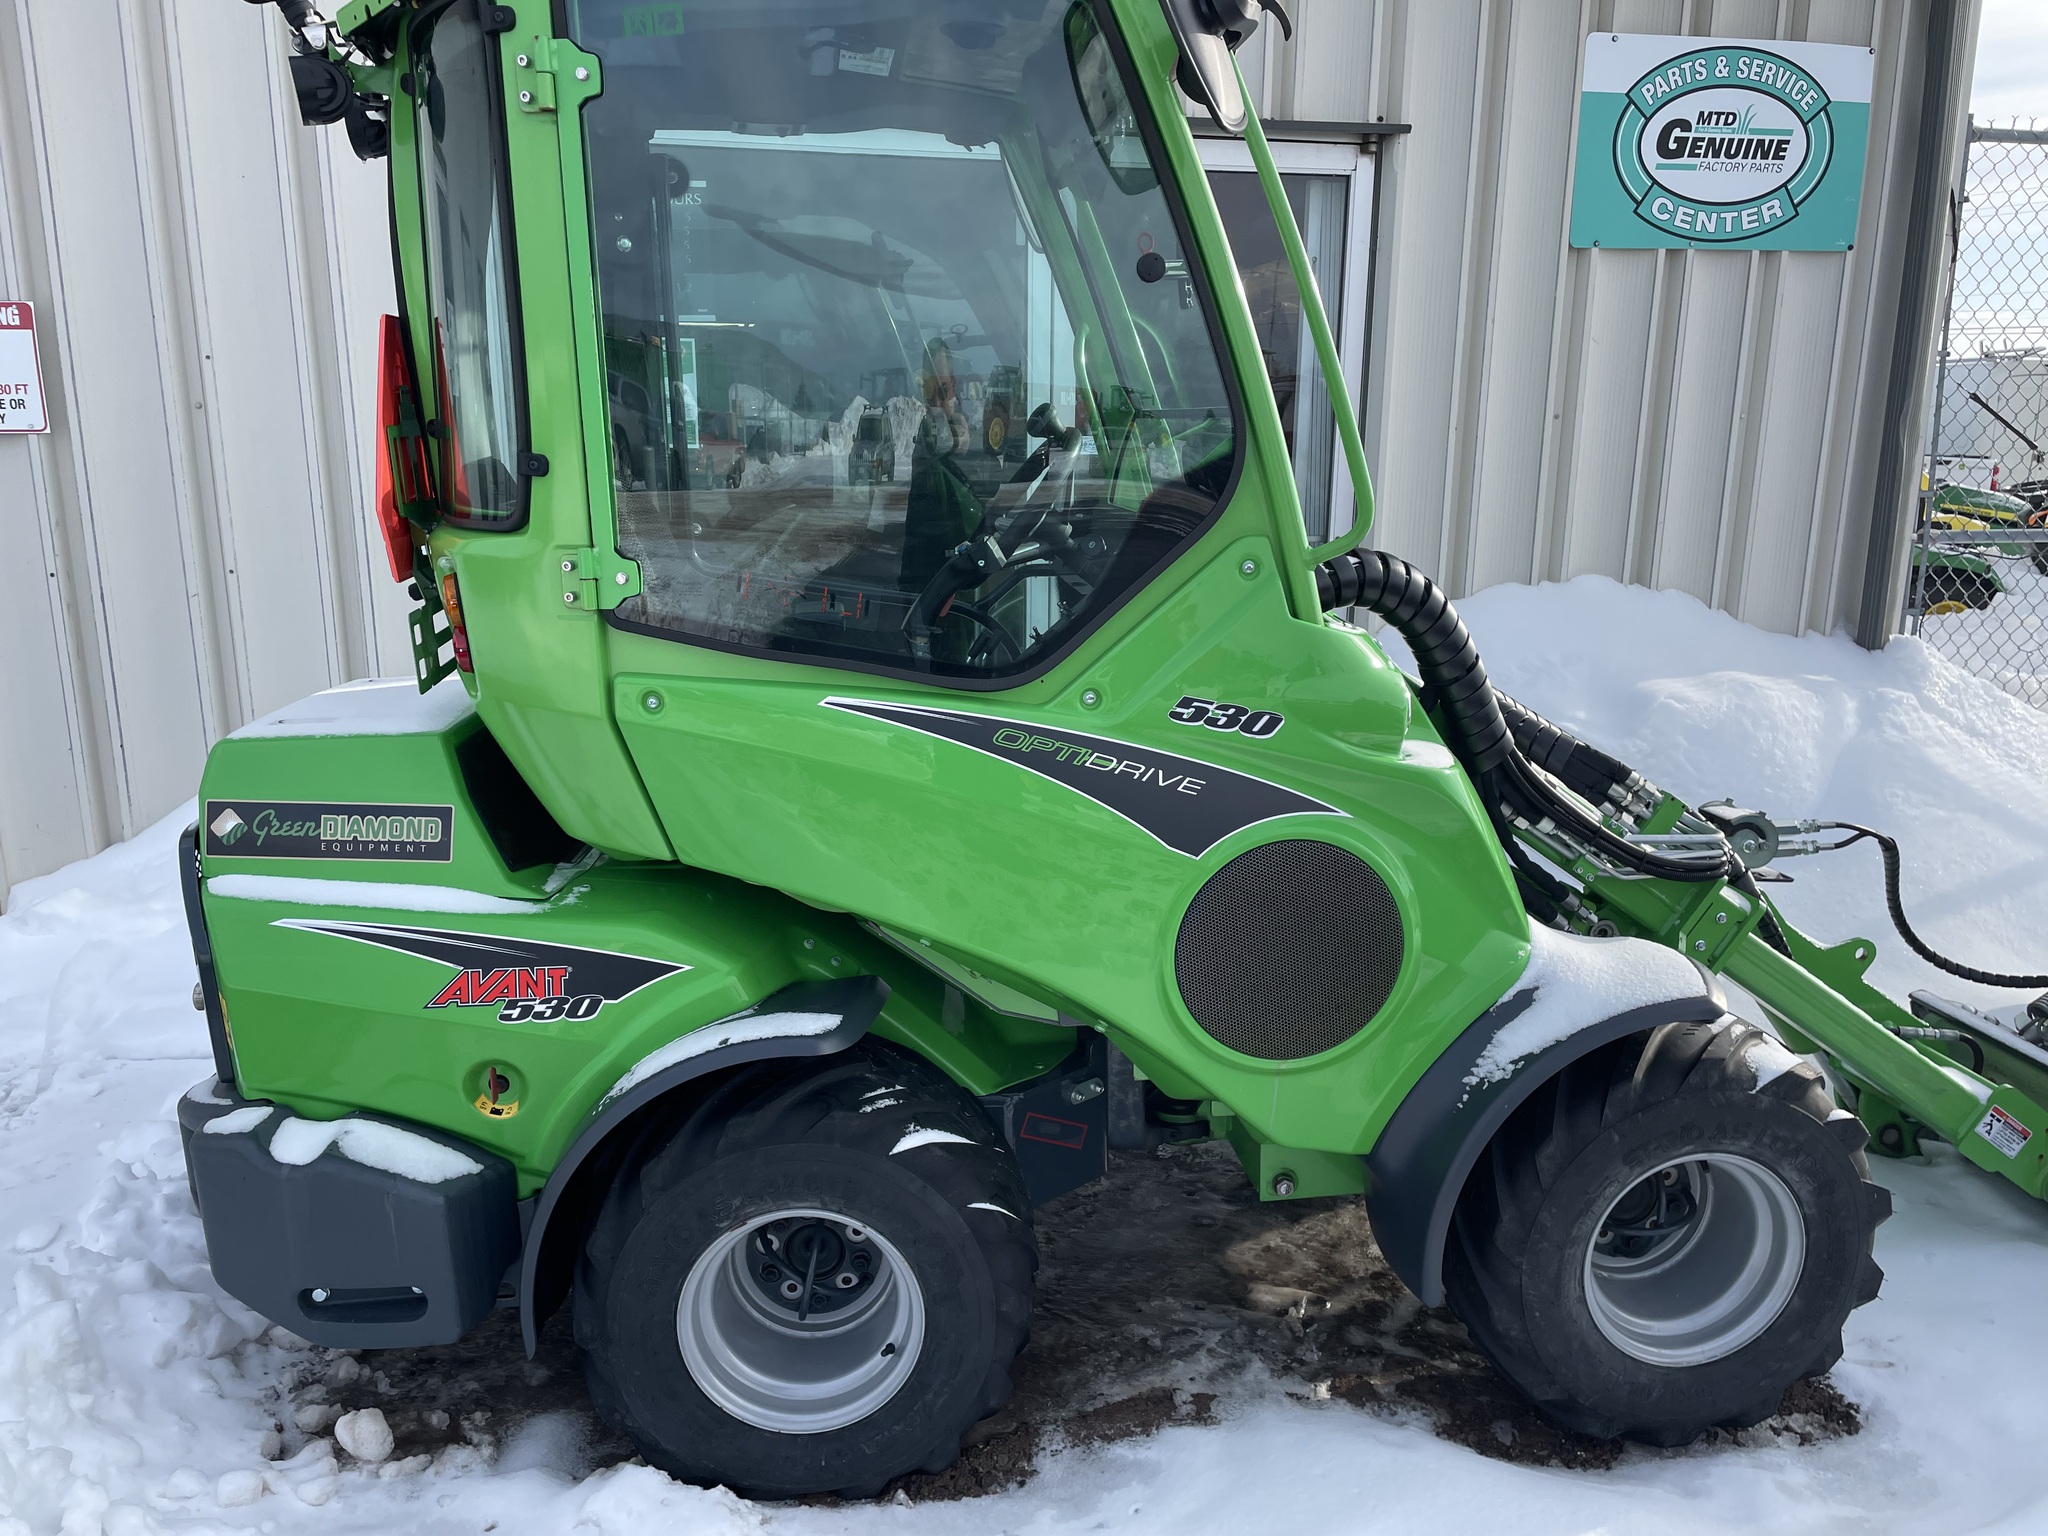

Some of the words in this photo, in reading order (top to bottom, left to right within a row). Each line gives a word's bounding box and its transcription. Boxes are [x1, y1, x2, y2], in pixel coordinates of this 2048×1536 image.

[1640, 58, 1708, 107] PARTS
[1714, 56, 1730, 78] &
[1736, 56, 1819, 112] SERVICE
[1696, 111, 1738, 126] MTD
[1656, 118, 1791, 161] GENUINE
[1698, 161, 1747, 173] FACTORY
[1749, 163, 1784, 174] PARTS
[670, 193, 702, 205] URS
[1651, 197, 1785, 234] CENTER
[9, 398, 26, 410] OR
[14, 384, 29, 395] FT
[1167, 695, 1285, 739] 530
[320, 814, 442, 843] DIAMOND
[321, 842, 427, 853] EQUIPMENT
[424, 966, 570, 1009] AVANT
[497, 994, 605, 1024] 530
